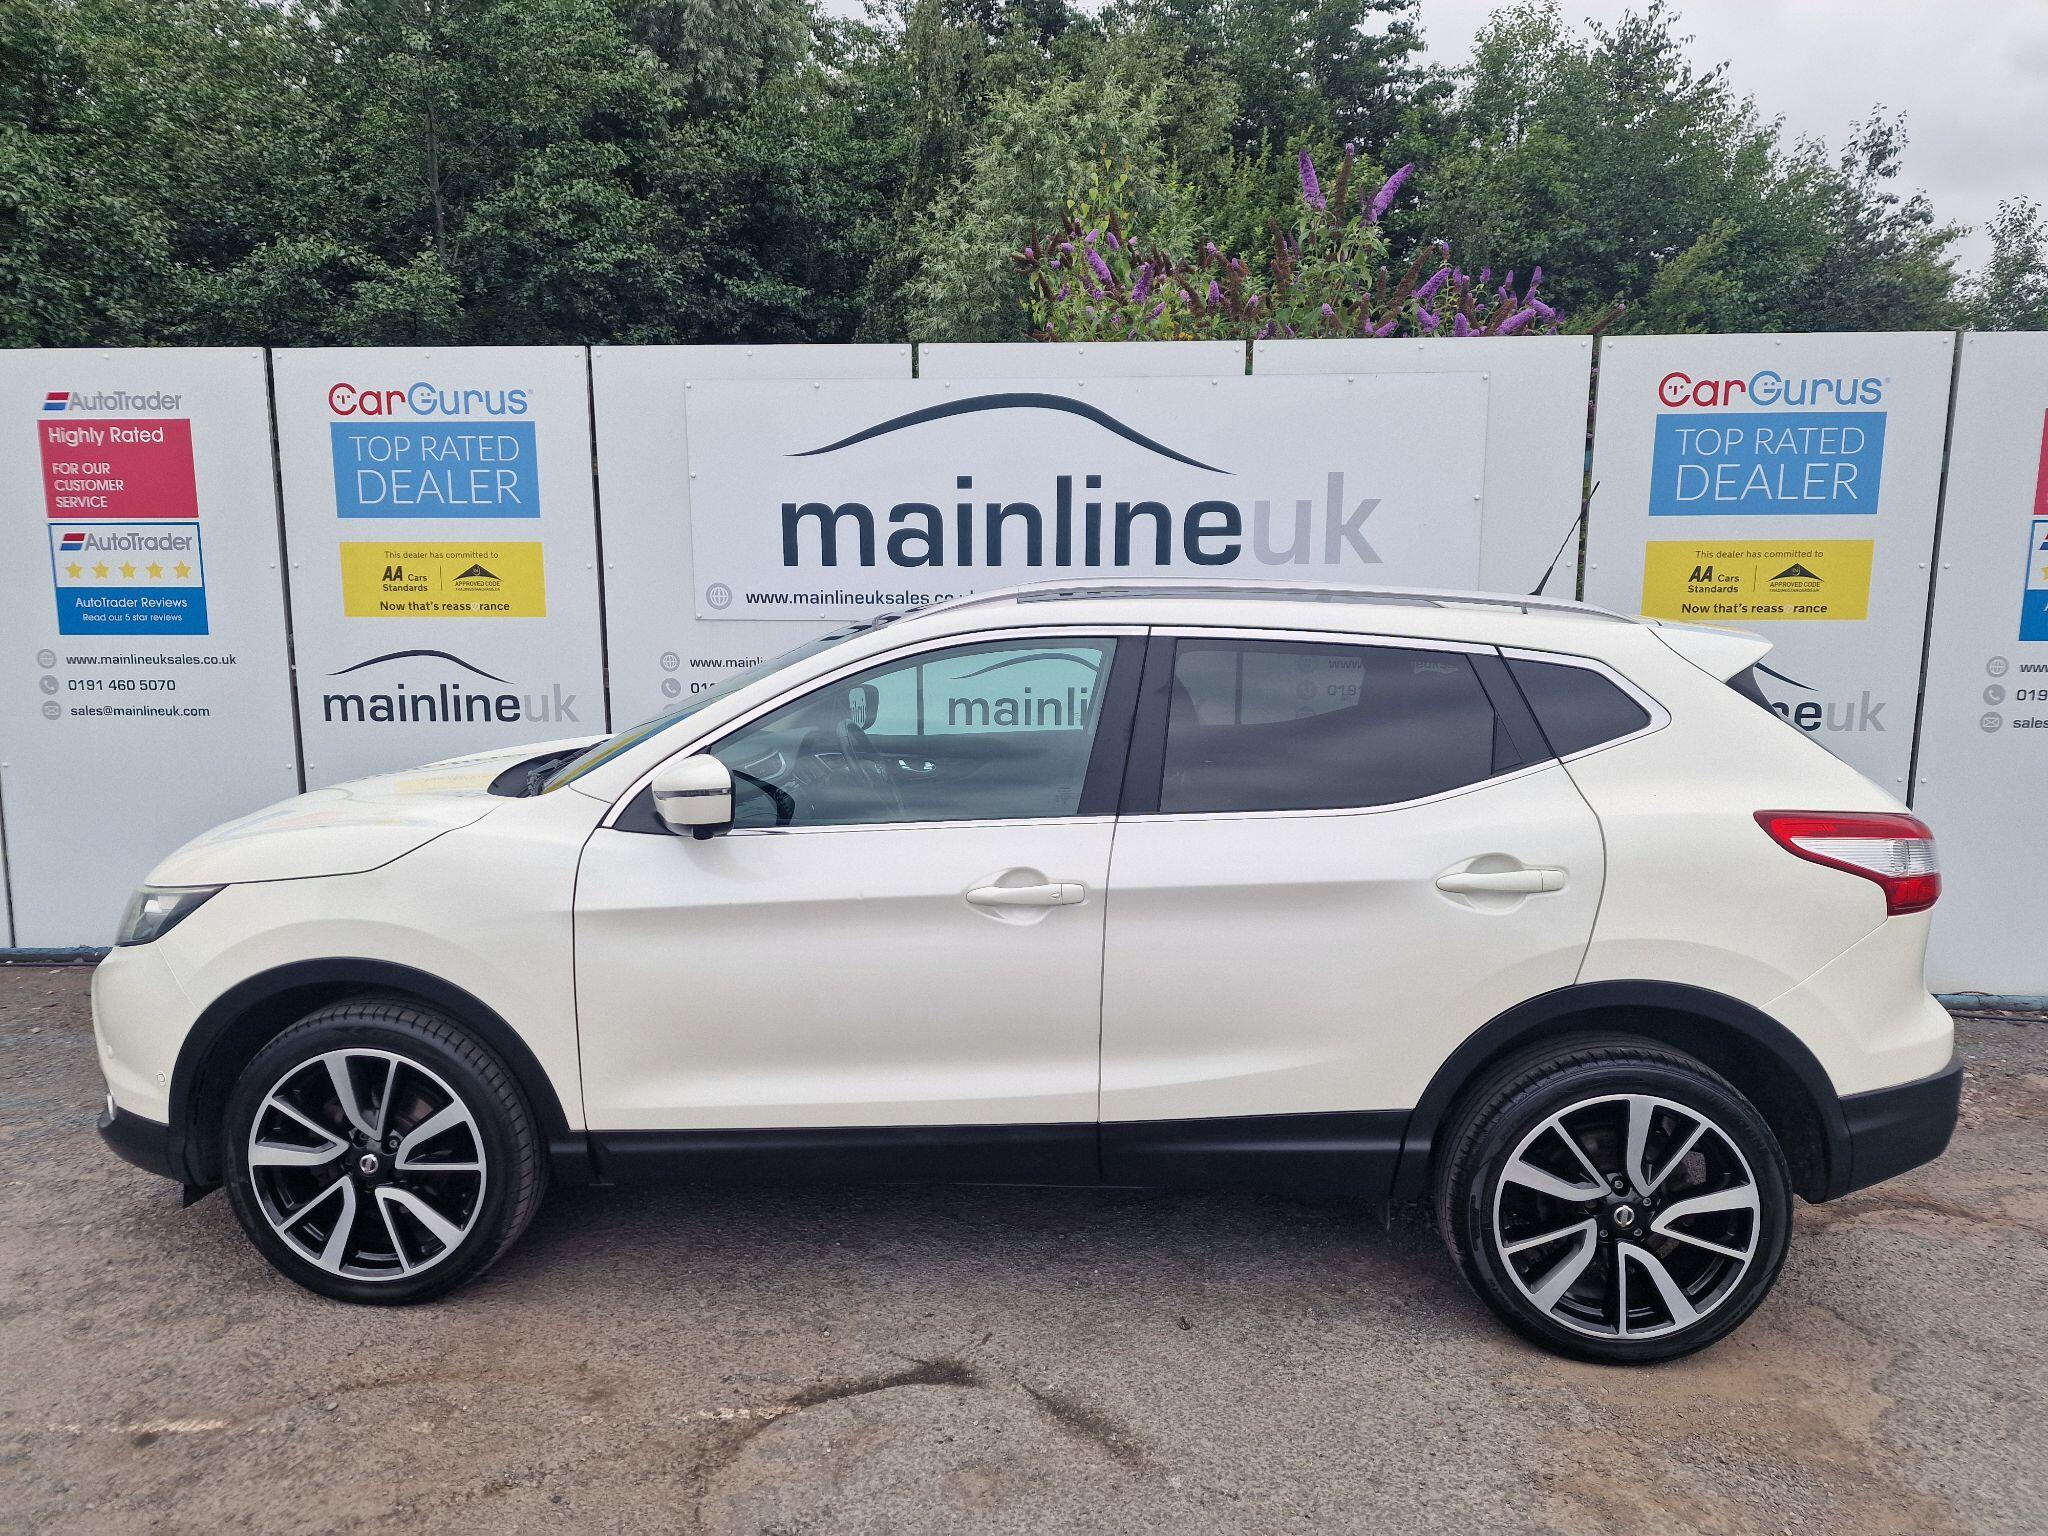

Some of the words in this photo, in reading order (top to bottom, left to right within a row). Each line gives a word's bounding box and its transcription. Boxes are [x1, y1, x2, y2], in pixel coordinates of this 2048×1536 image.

[1658, 370, 1882, 408] CarGurus
[69, 391, 182, 410] AutoTrader
[328, 381, 528, 415] CarGurus
[48, 427, 105, 446] Highly
[110, 427, 164, 443] Rated
[1675, 428, 1744, 456] TOP
[1754, 427, 1865, 455] RATED
[348, 436, 411, 462] TOP
[421, 436, 520, 461] RATED
[52, 463, 79, 475] FOR
[82, 463, 111, 475] OUR
[54, 479, 124, 491] CUSTOMER
[356, 469, 522, 505] DEALER
[1675, 462, 1859, 502] DEALER
[56, 496, 108, 508] SERVICE
[781, 471, 1384, 567] mainlineuk
[85, 532, 193, 551] AutoTrader
[1764, 550, 1812, 558] committed
[382, 566, 403, 581] AA
[1688, 565, 1714, 582] AA
[1717, 574, 1740, 582] Cars
[382, 584, 428, 592] Standards
[1687, 585, 1739, 593] Standards
[76, 597, 139, 608] AutoTrader
[141, 597, 188, 608] Reviews
[380, 601, 405, 611] Now
[408, 601, 439, 611] that's
[442, 602, 510, 611] reassrance
[1681, 603, 1711, 613] Now
[1713, 603, 1748, 613] that's
[1751, 603, 1828, 613] reassrance
[83, 613, 105, 621] Read
[125, 613, 131, 621] 5
[150, 613, 183, 621] reviews
[66, 654, 237, 666] www.mainlineuksales.co.uk
[68, 679, 104, 691] 0191
[108, 679, 136, 691] 460
[139, 679, 176, 691] 5070
[323, 683, 580, 723] mainlineuk
[70, 705, 210, 717] sales@mainlineuk.com
